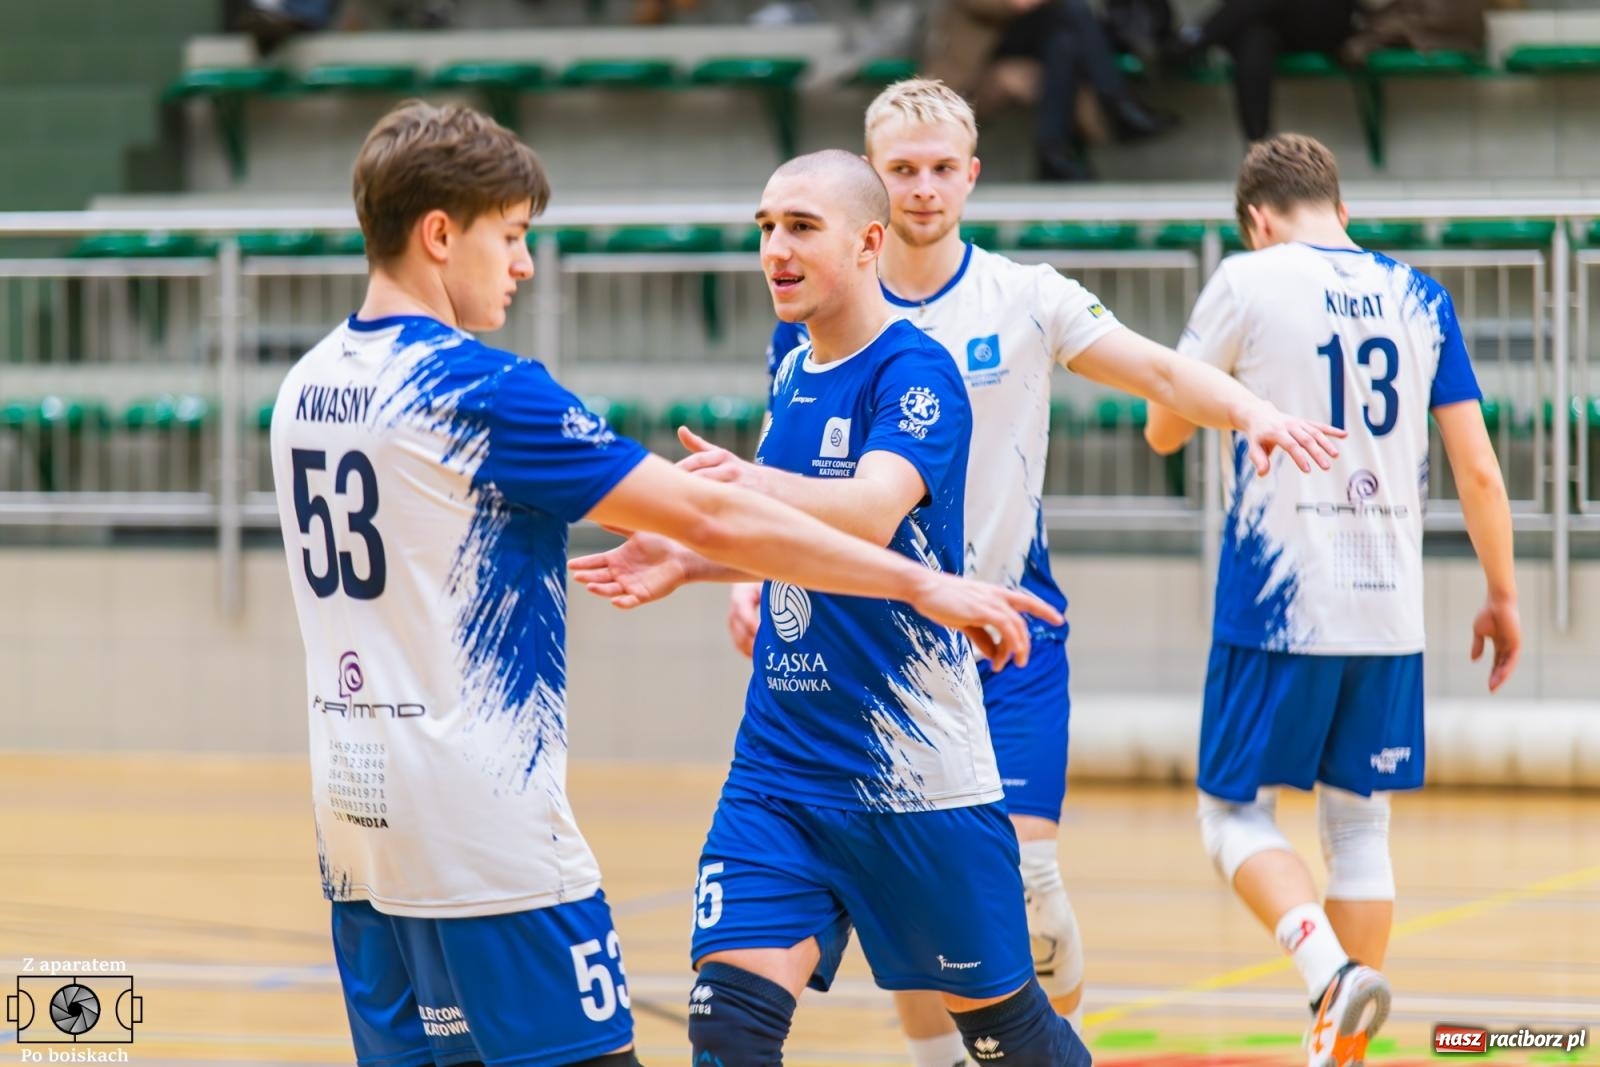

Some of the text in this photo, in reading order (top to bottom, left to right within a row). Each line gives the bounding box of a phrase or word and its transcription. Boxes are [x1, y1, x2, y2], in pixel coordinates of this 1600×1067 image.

[296, 381, 377, 424] KWAŚNY
[1317, 332, 1399, 436] 13
[291, 448, 387, 600] 53
[569, 929, 631, 1022] 53
